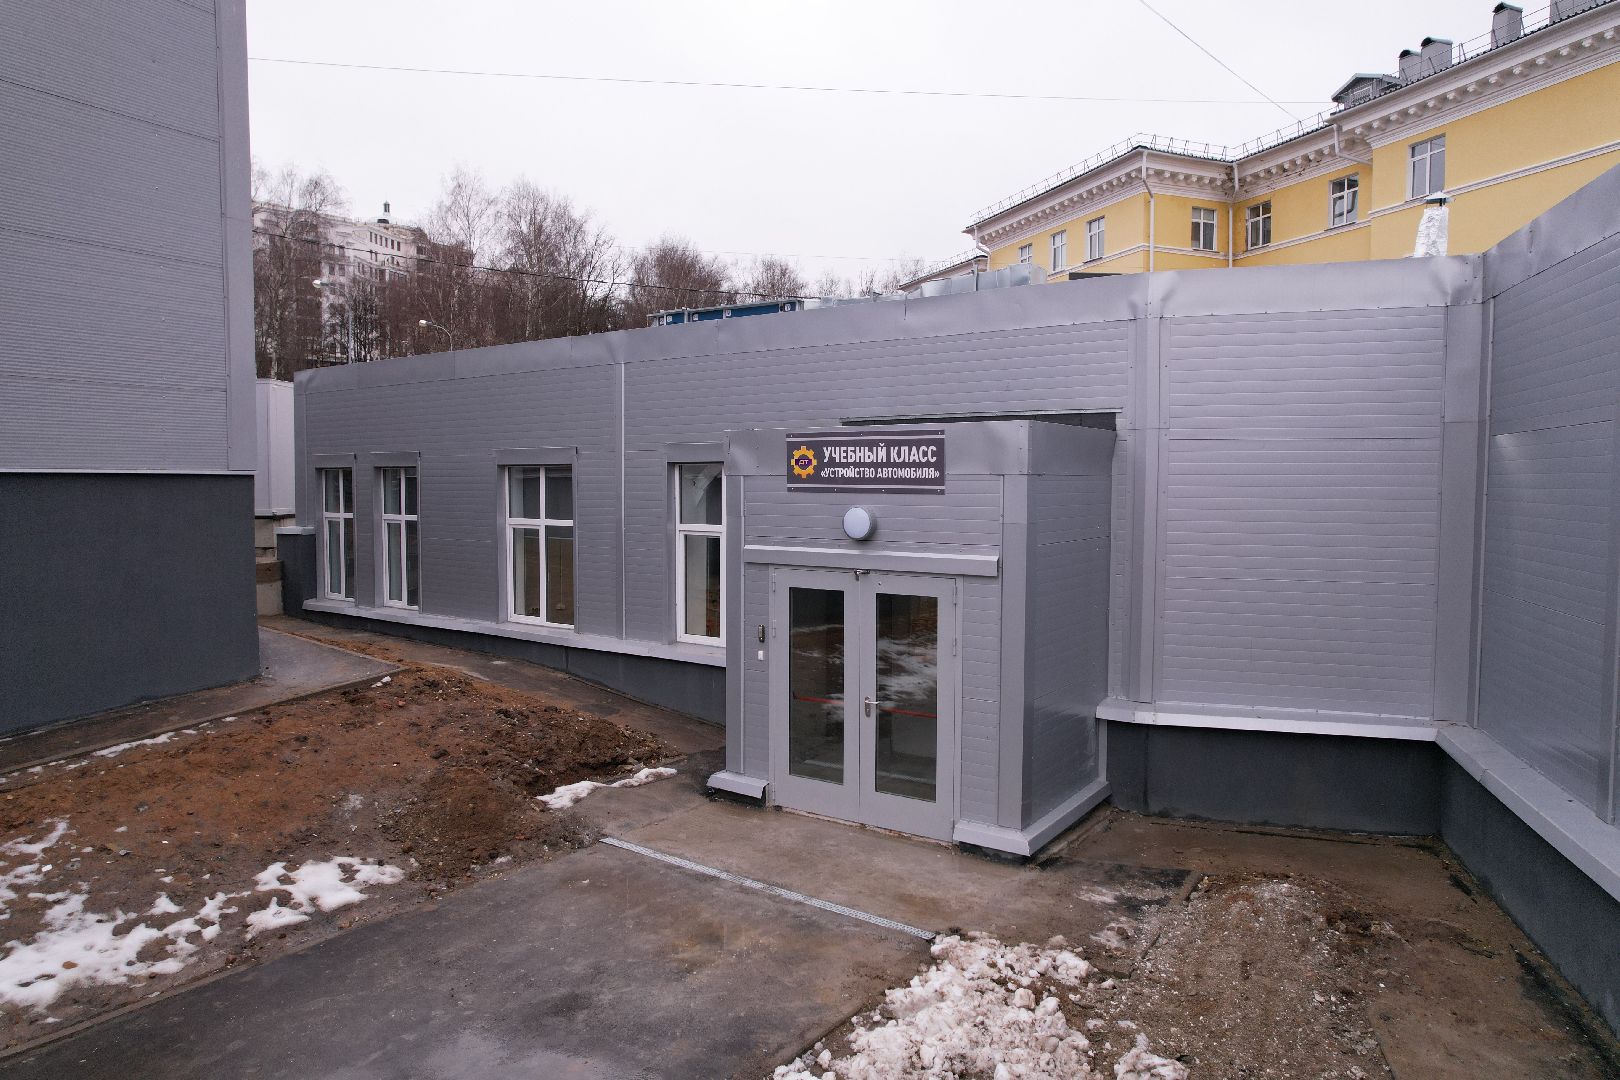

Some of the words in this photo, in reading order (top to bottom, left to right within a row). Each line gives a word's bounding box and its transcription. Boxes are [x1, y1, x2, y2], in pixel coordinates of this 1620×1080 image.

[823, 443, 887, 463] УЧЕБНЫЙ
[890, 446, 937, 463] КЛАСС
[820, 466, 875, 478] «УСТРОЙСТВО
[877, 467, 940, 479] АВТОМОБИЛЯ»
